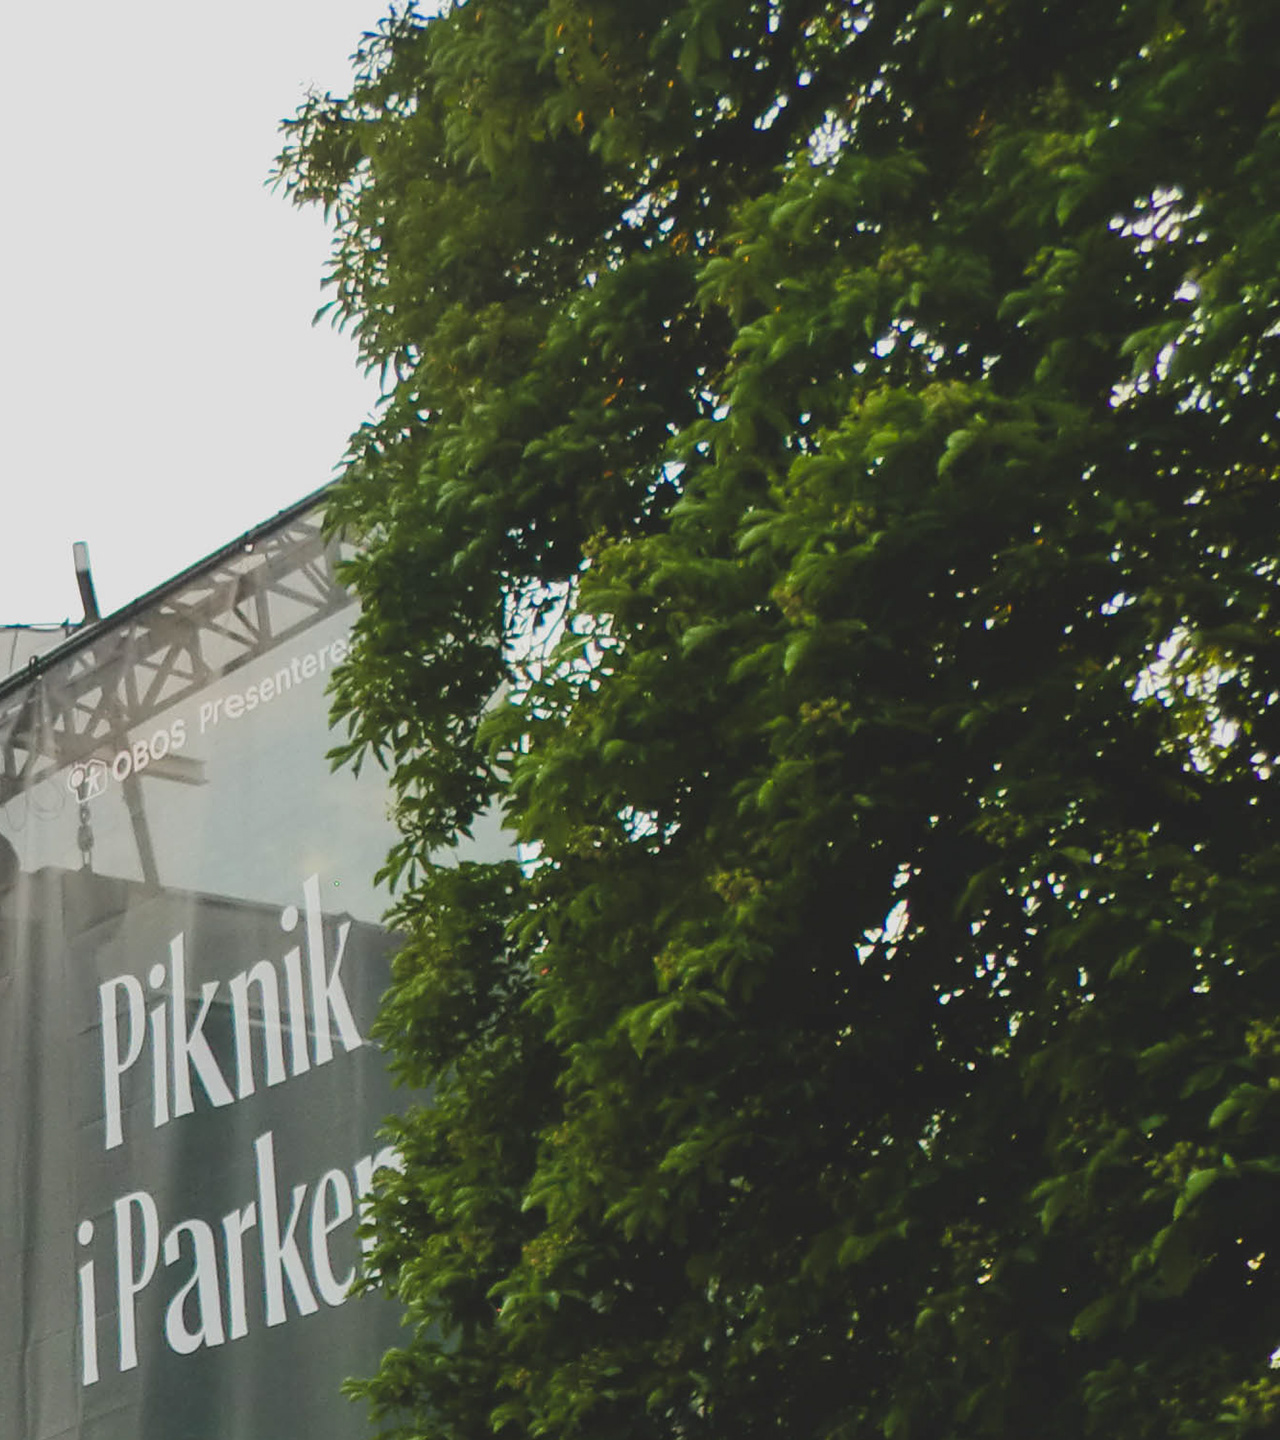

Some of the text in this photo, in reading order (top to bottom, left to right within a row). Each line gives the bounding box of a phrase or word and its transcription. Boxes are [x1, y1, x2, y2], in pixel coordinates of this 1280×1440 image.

[112, 719, 187, 782] OBOS
[99, 873, 364, 1150] Piknik
[77, 1219, 100, 1386] i
